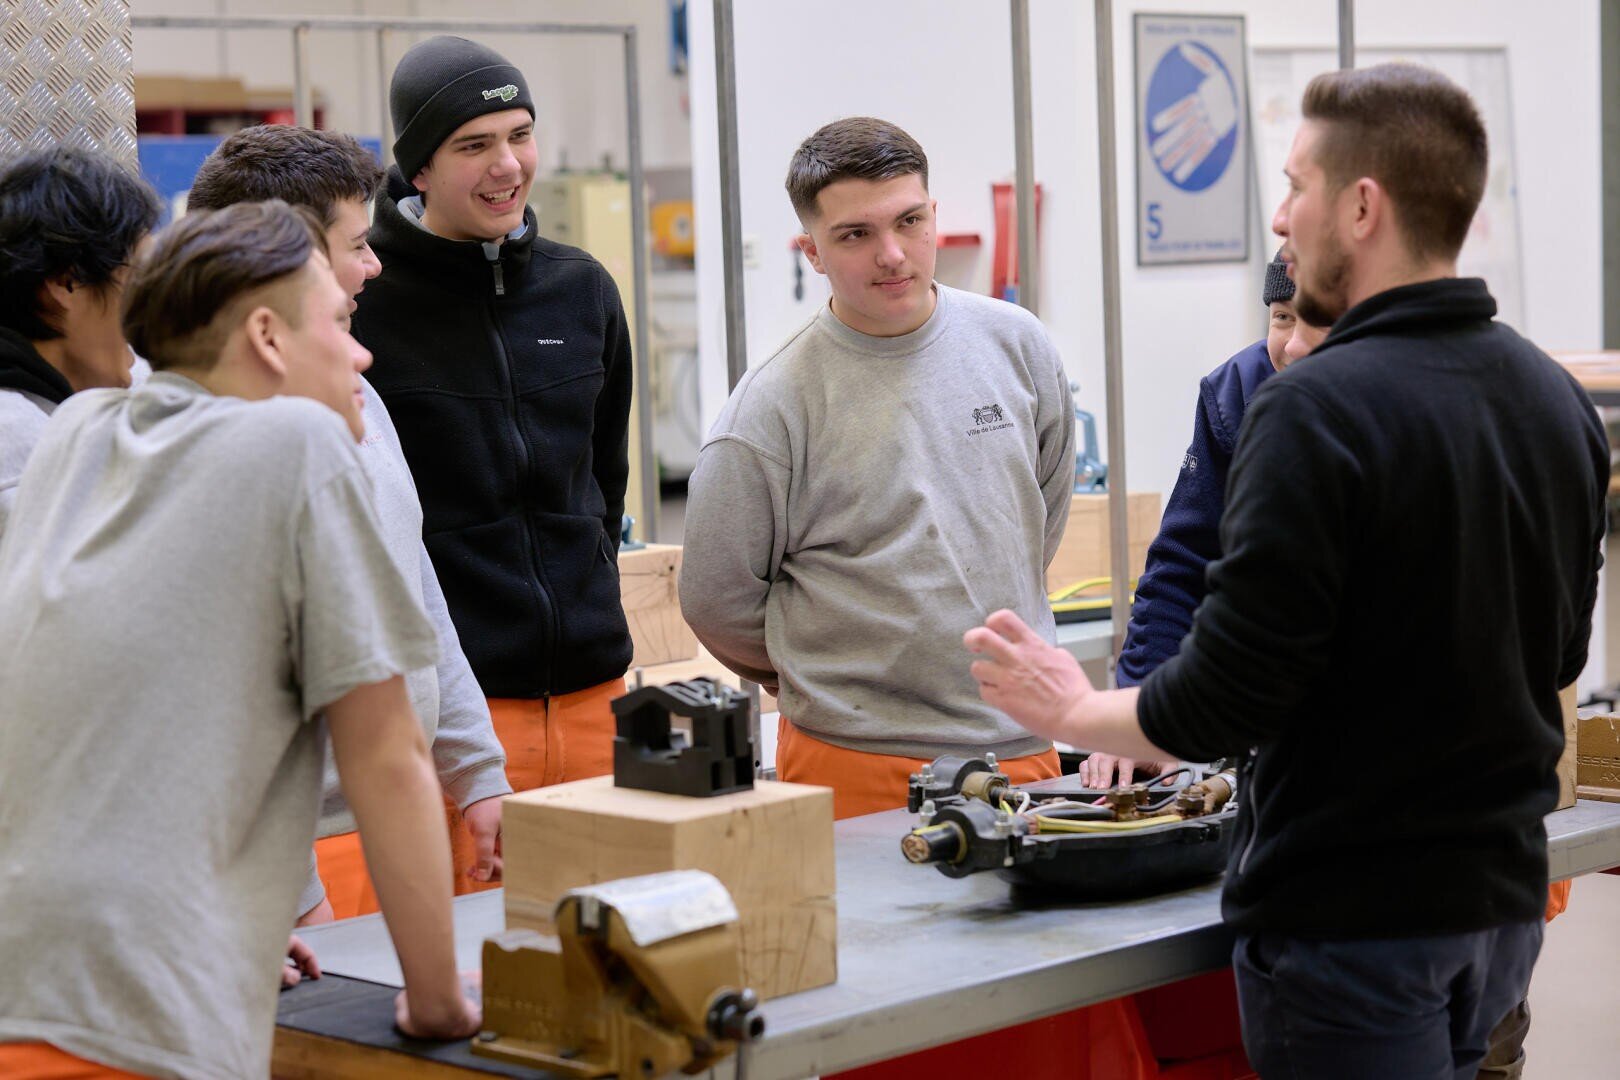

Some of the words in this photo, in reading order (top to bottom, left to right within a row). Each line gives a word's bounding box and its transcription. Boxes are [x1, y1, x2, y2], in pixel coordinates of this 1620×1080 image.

[1147, 203, 1162, 239] 5
[967, 429, 981, 437] Ville
[990, 422, 1015, 432] Lausanne
